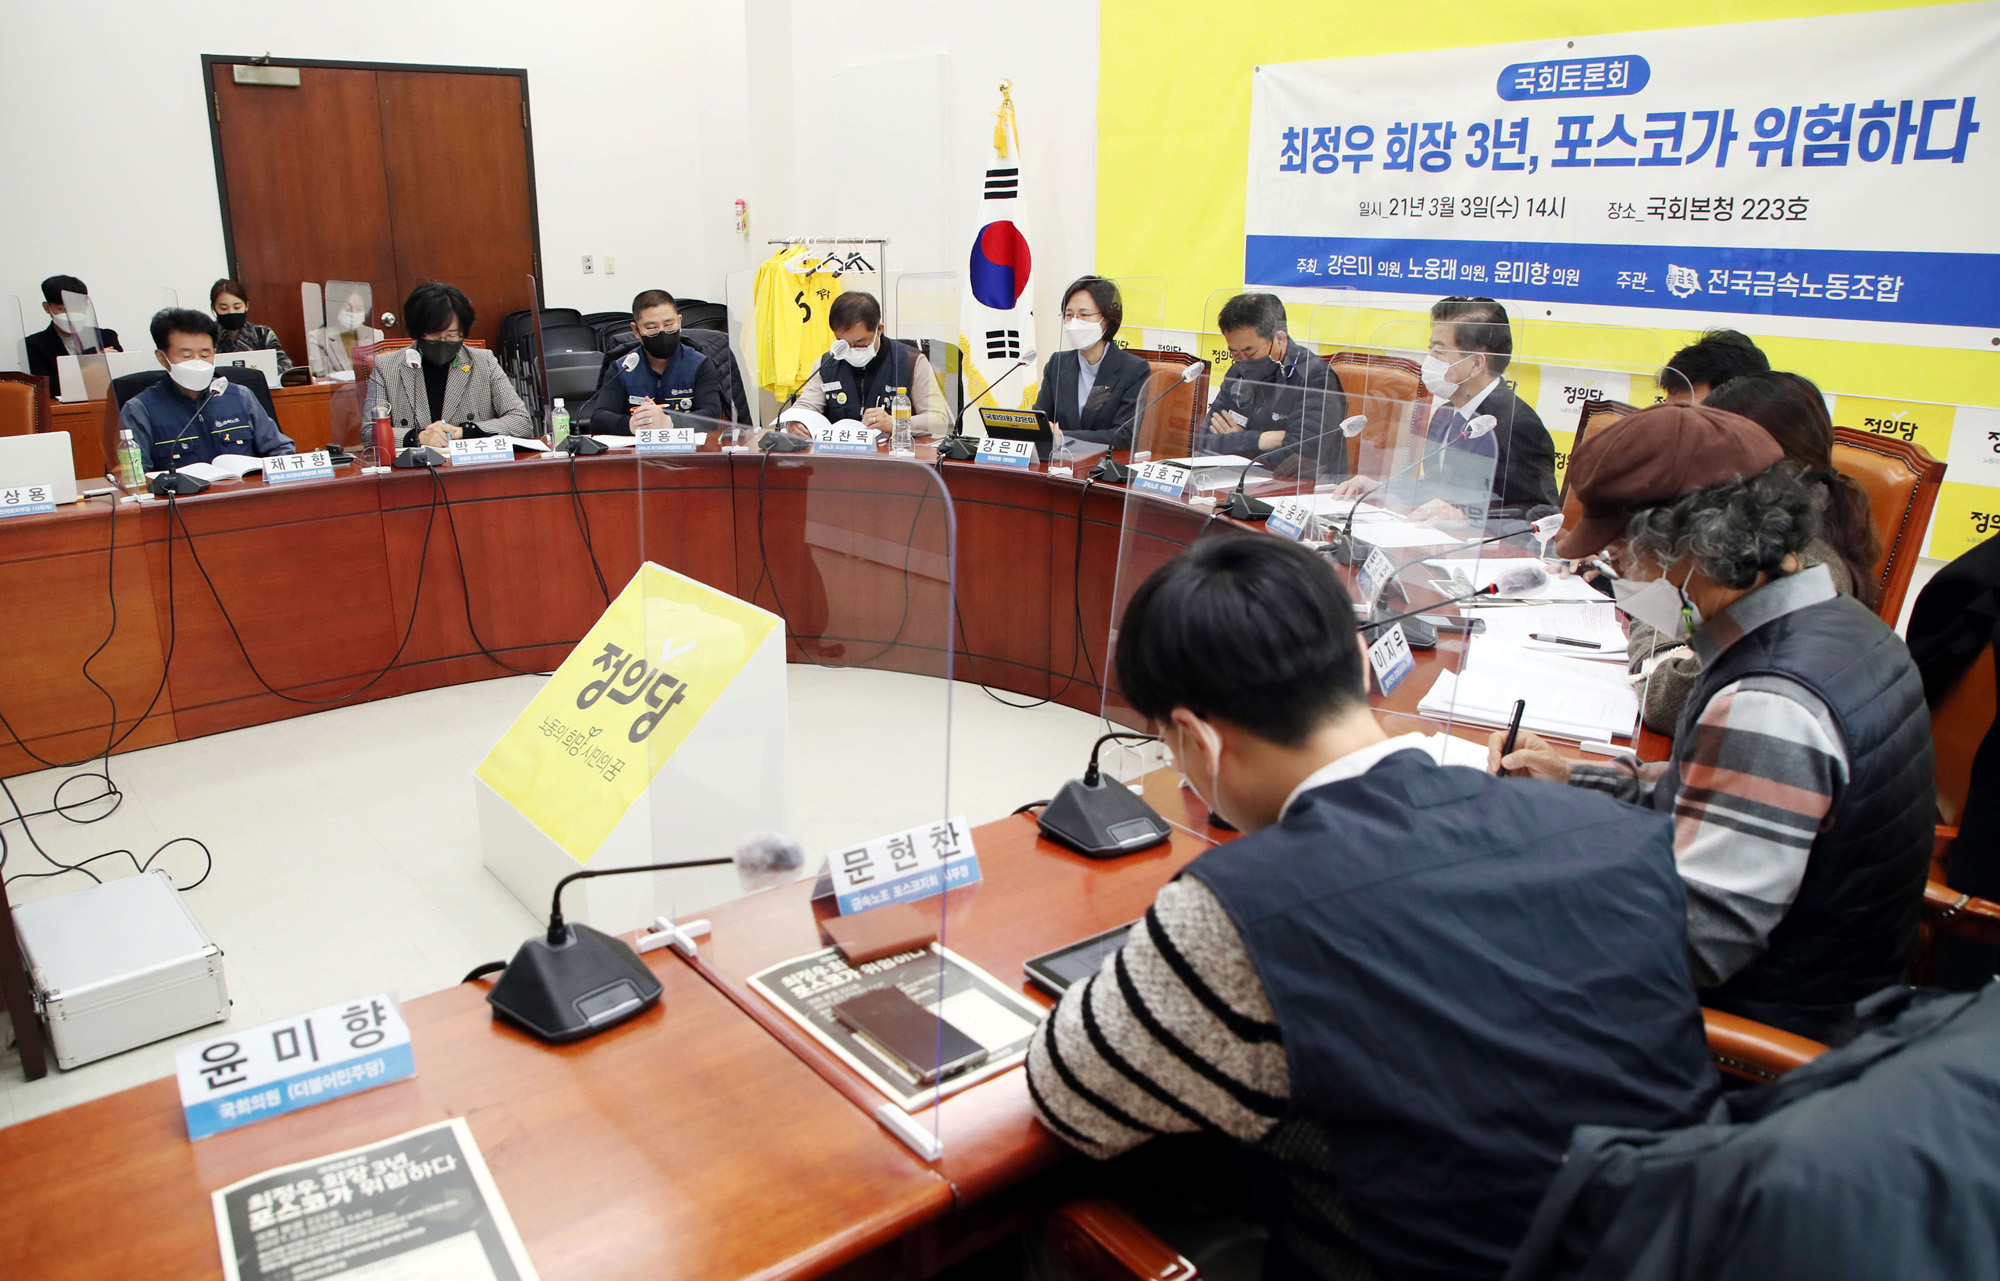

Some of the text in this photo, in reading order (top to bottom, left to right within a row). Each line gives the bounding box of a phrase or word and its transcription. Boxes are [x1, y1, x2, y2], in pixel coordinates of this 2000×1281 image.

[1514, 60, 1630, 94] 국회토론회
[1280, 96, 1980, 175] 최정우 회장 3년, 포스코가 위험하다
[1428, 196, 1455, 218] 3월
[1461, 195, 1519, 219] 3일(수)
[1526, 196, 1566, 219] 14시
[1741, 196, 1810, 221] 223호
[1327, 254, 1373, 277] 강은미
[1377, 260, 1403, 278] 의원,
[1407, 257, 1457, 281] 노웅래
[1460, 264, 1489, 283] 의원,
[1493, 260, 1550, 286] 윤미향
[1552, 268, 1580, 287] 의원
[1707, 269, 1904, 303] 전국금속노동조합
[794, 290, 812, 323] 5
[640, 429, 689, 443] 정용식
[822, 429, 869, 443] 김찬목
[1013, 415, 1037, 424] 강은미
[271, 453, 325, 471] 채규향
[455, 438, 507, 453] 박수완
[983, 439, 1029, 457] 강은미
[1142, 463, 1185, 485] 김호규
[576, 641, 688, 743] 정의당
[538, 715, 626, 782] 노동의 희망 시민의 꿈
[842, 821, 962, 886] 문현찬
[200, 1000, 387, 1091] 윤미향
[218, 1057, 385, 1120] 국회의원 (더불어민주당)
